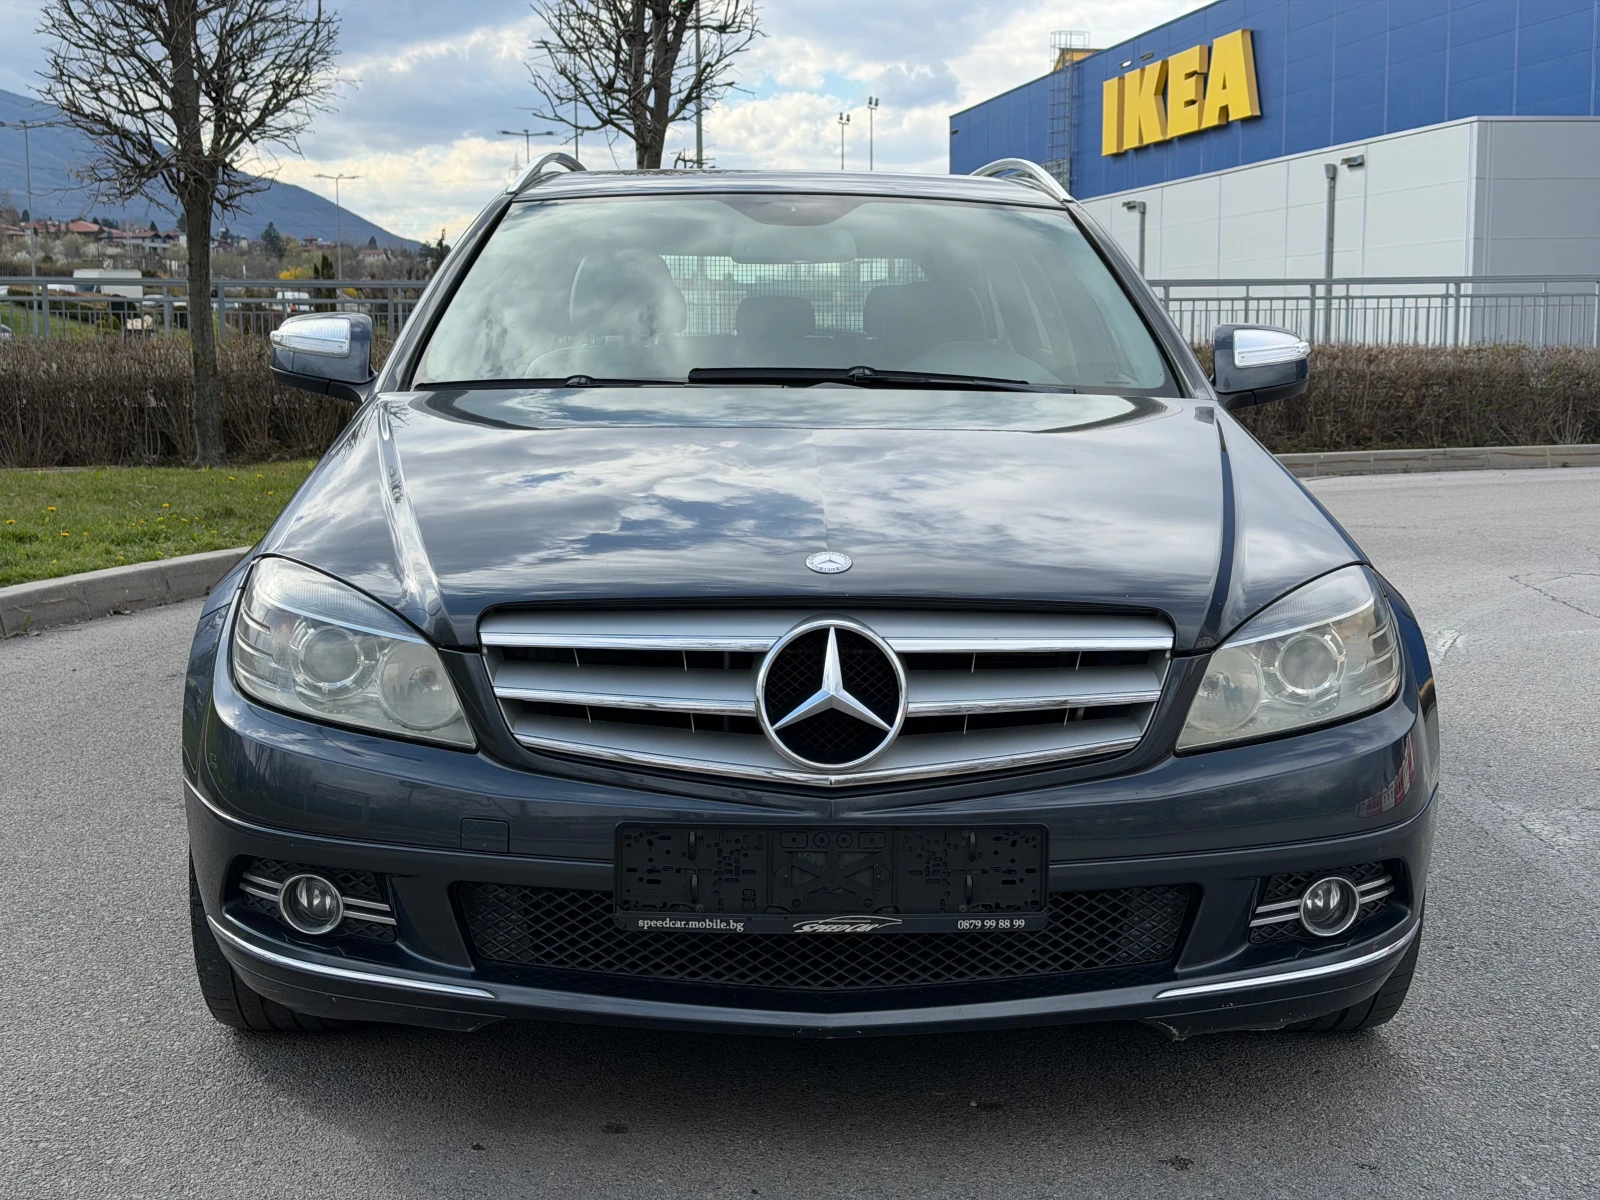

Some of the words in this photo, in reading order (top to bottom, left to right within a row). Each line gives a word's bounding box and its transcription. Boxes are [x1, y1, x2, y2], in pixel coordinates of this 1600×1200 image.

[1102, 29, 1261, 156] IKEA
[638, 918, 744, 932] speedcar.mobile.bg
[957, 919, 982, 930] 0879
[983, 919, 996, 930] 99
[998, 919, 1011, 929] 88
[1012, 918, 1025, 929] 99
